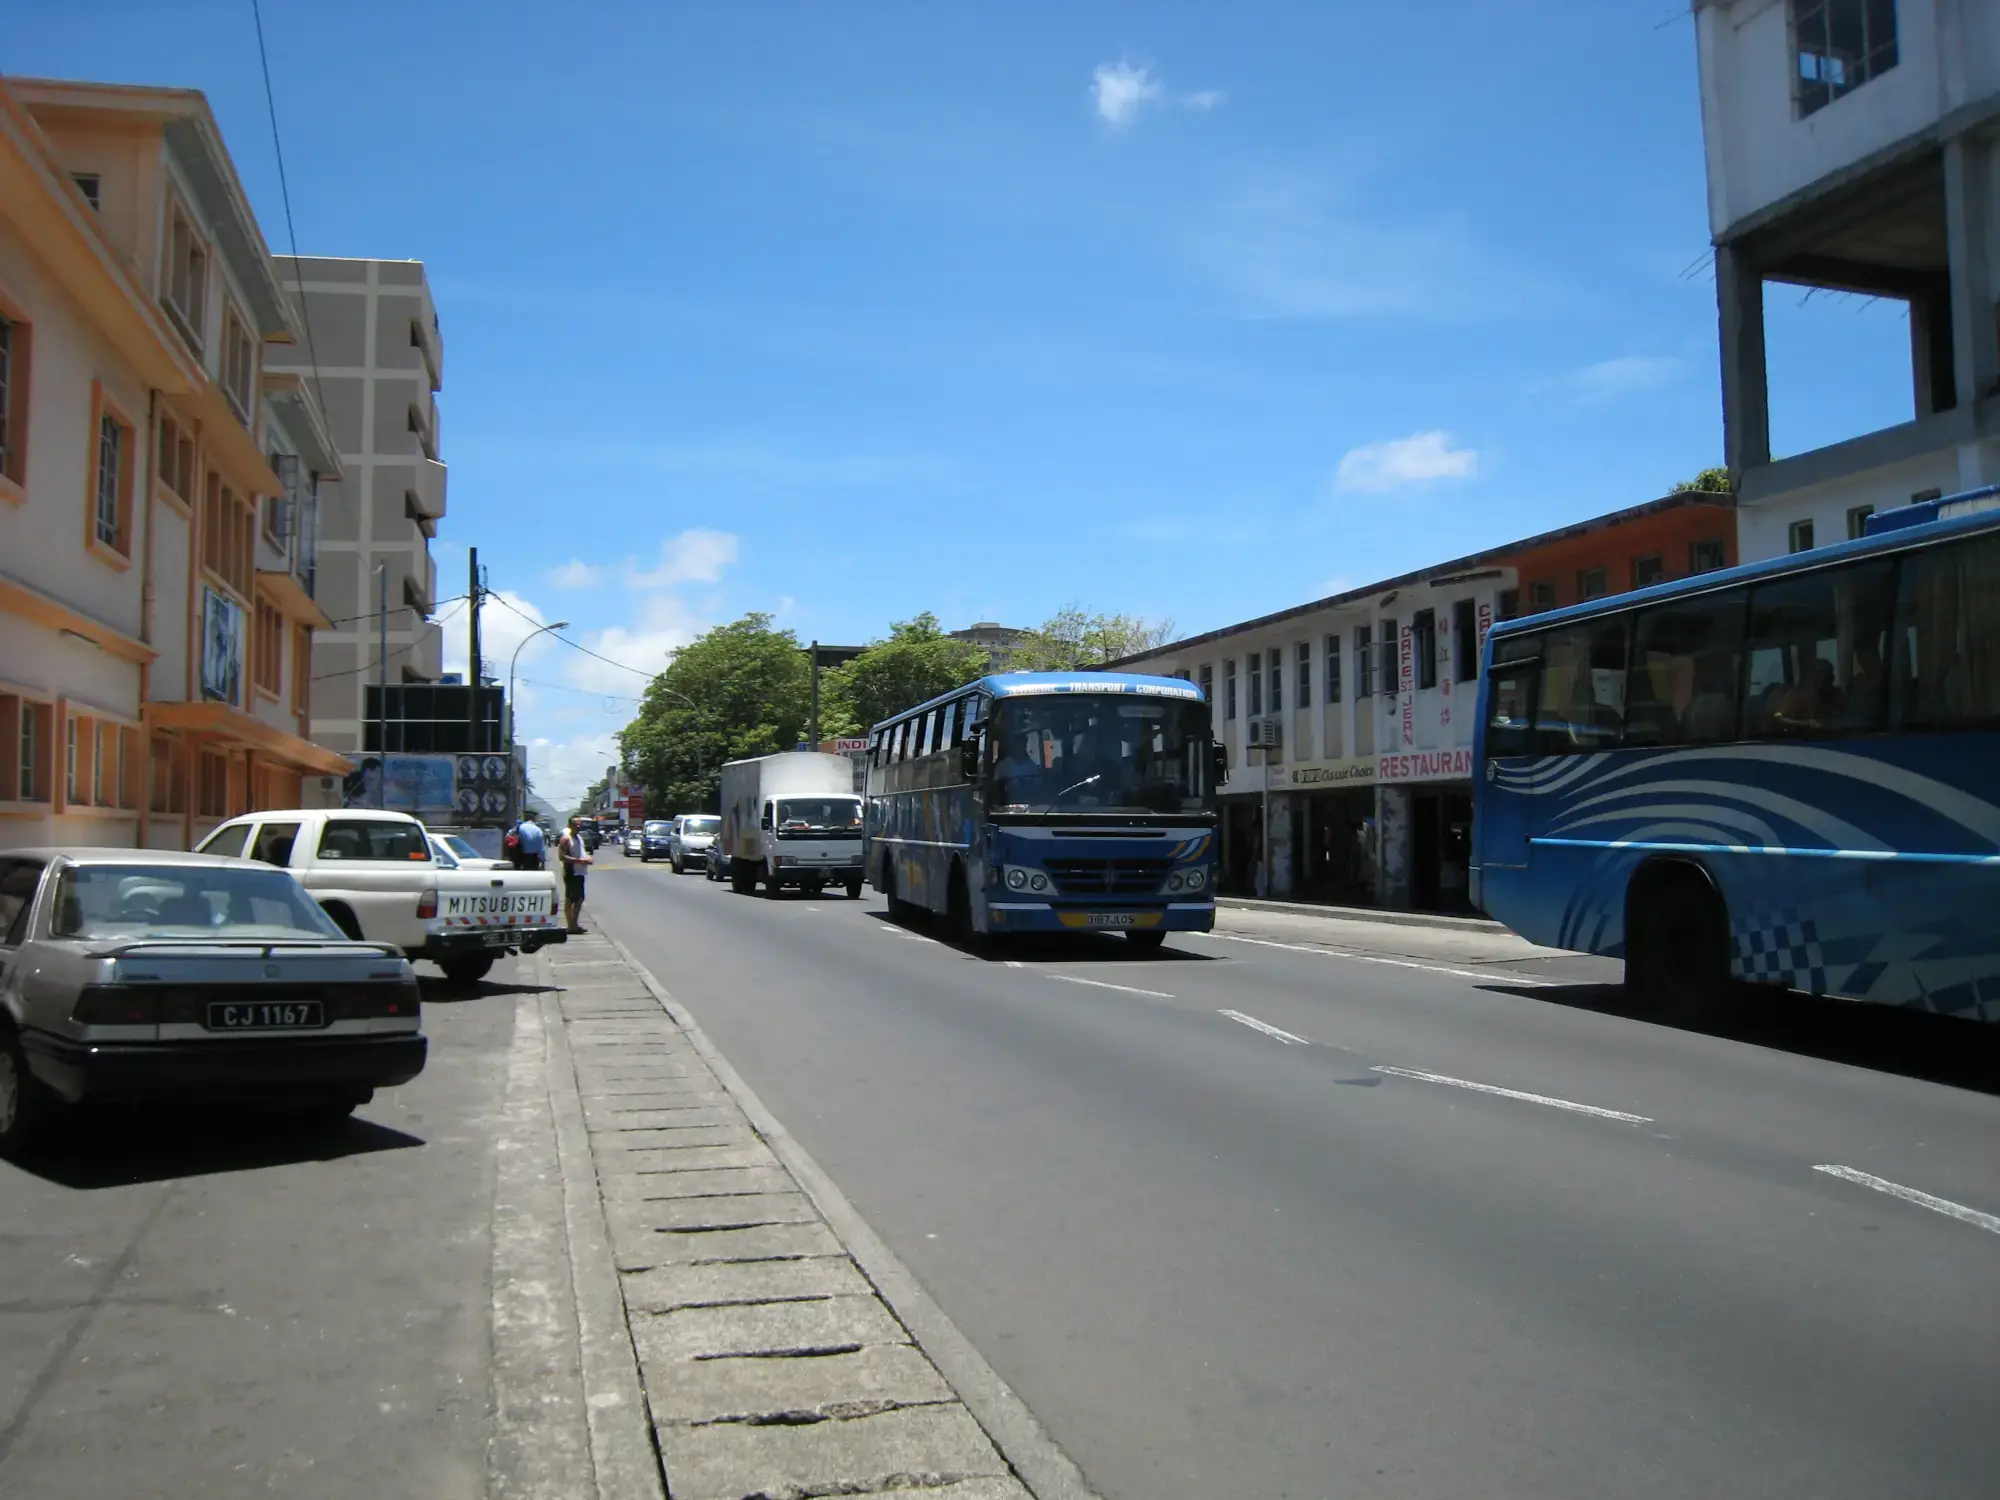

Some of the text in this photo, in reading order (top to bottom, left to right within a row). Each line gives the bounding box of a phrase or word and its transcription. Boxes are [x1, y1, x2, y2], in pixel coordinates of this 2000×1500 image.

[1401, 625, 1413, 677] CAFE
[1068, 682, 1128, 692] TRANSPORT
[1136, 684, 1198, 698] CORPORATION
[1402, 694, 1414, 745] JEAN
[1321, 766, 1349, 782] Classic
[1350, 764, 1375, 777] Choice
[448, 896, 544, 914] MITSUBISHI
[223, 1004, 309, 1026] CJ 1167
